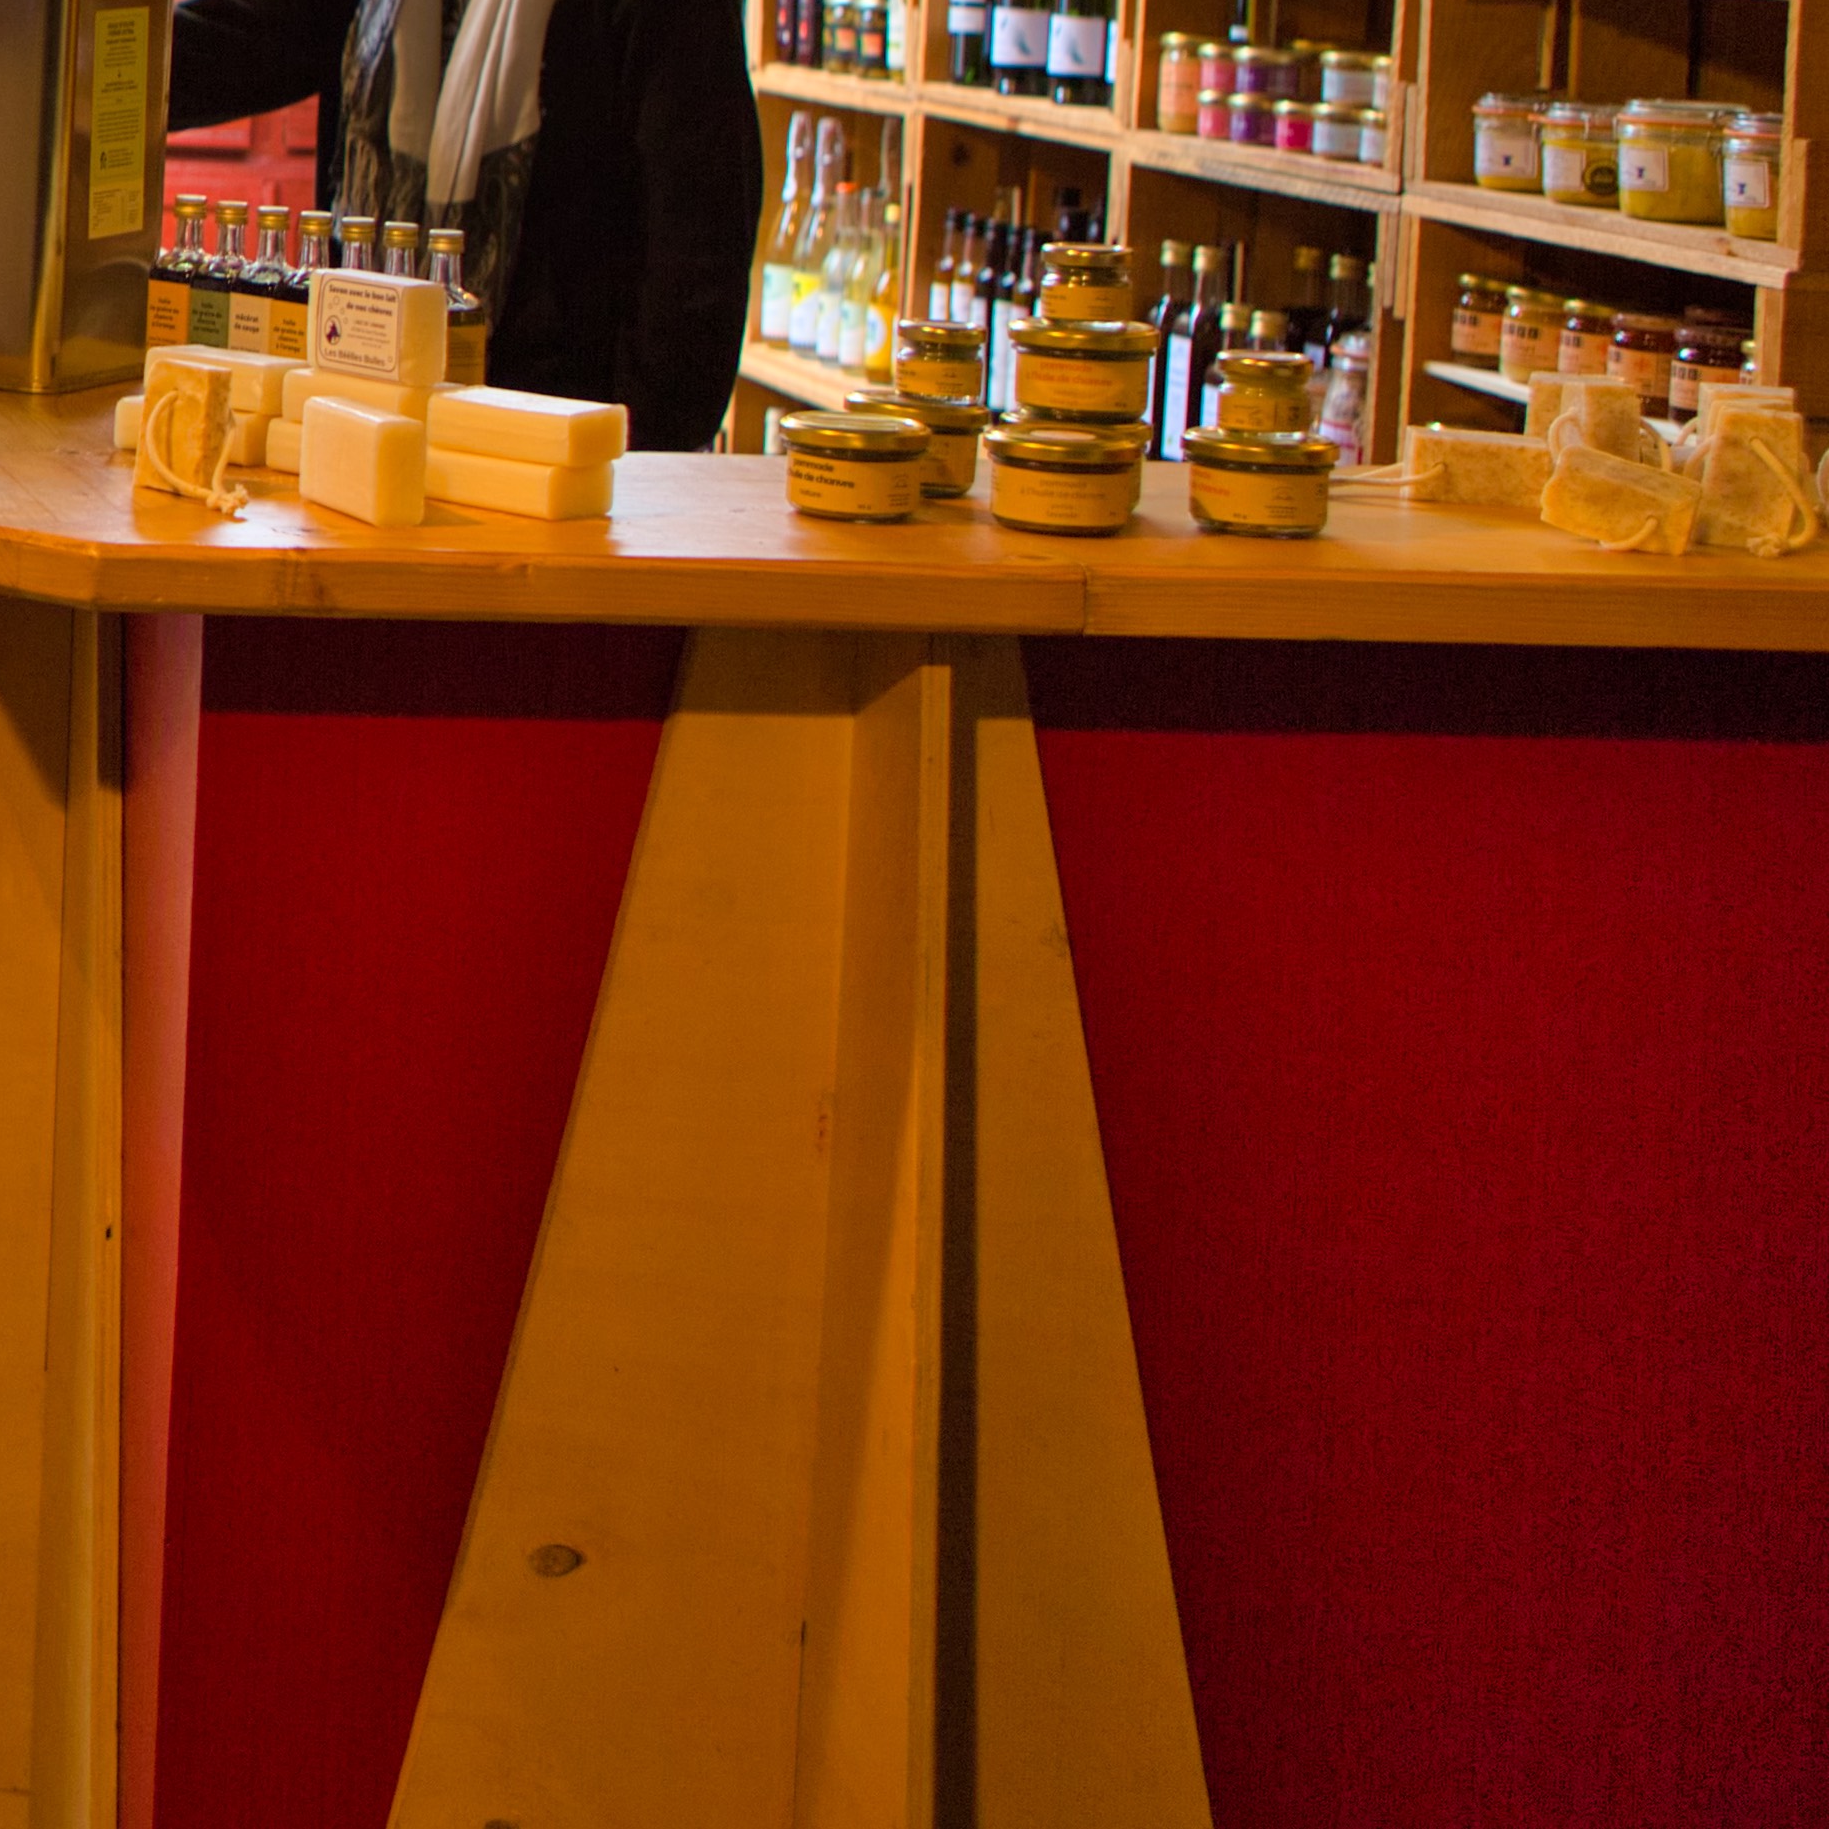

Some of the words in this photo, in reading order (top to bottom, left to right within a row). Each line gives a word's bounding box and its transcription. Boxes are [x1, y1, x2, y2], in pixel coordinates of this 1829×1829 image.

[329, 284, 347, 295] Savon
[348, 288, 363, 297] avec
[346, 299, 354, 309] de
[814, 474, 855, 489] chanvre
